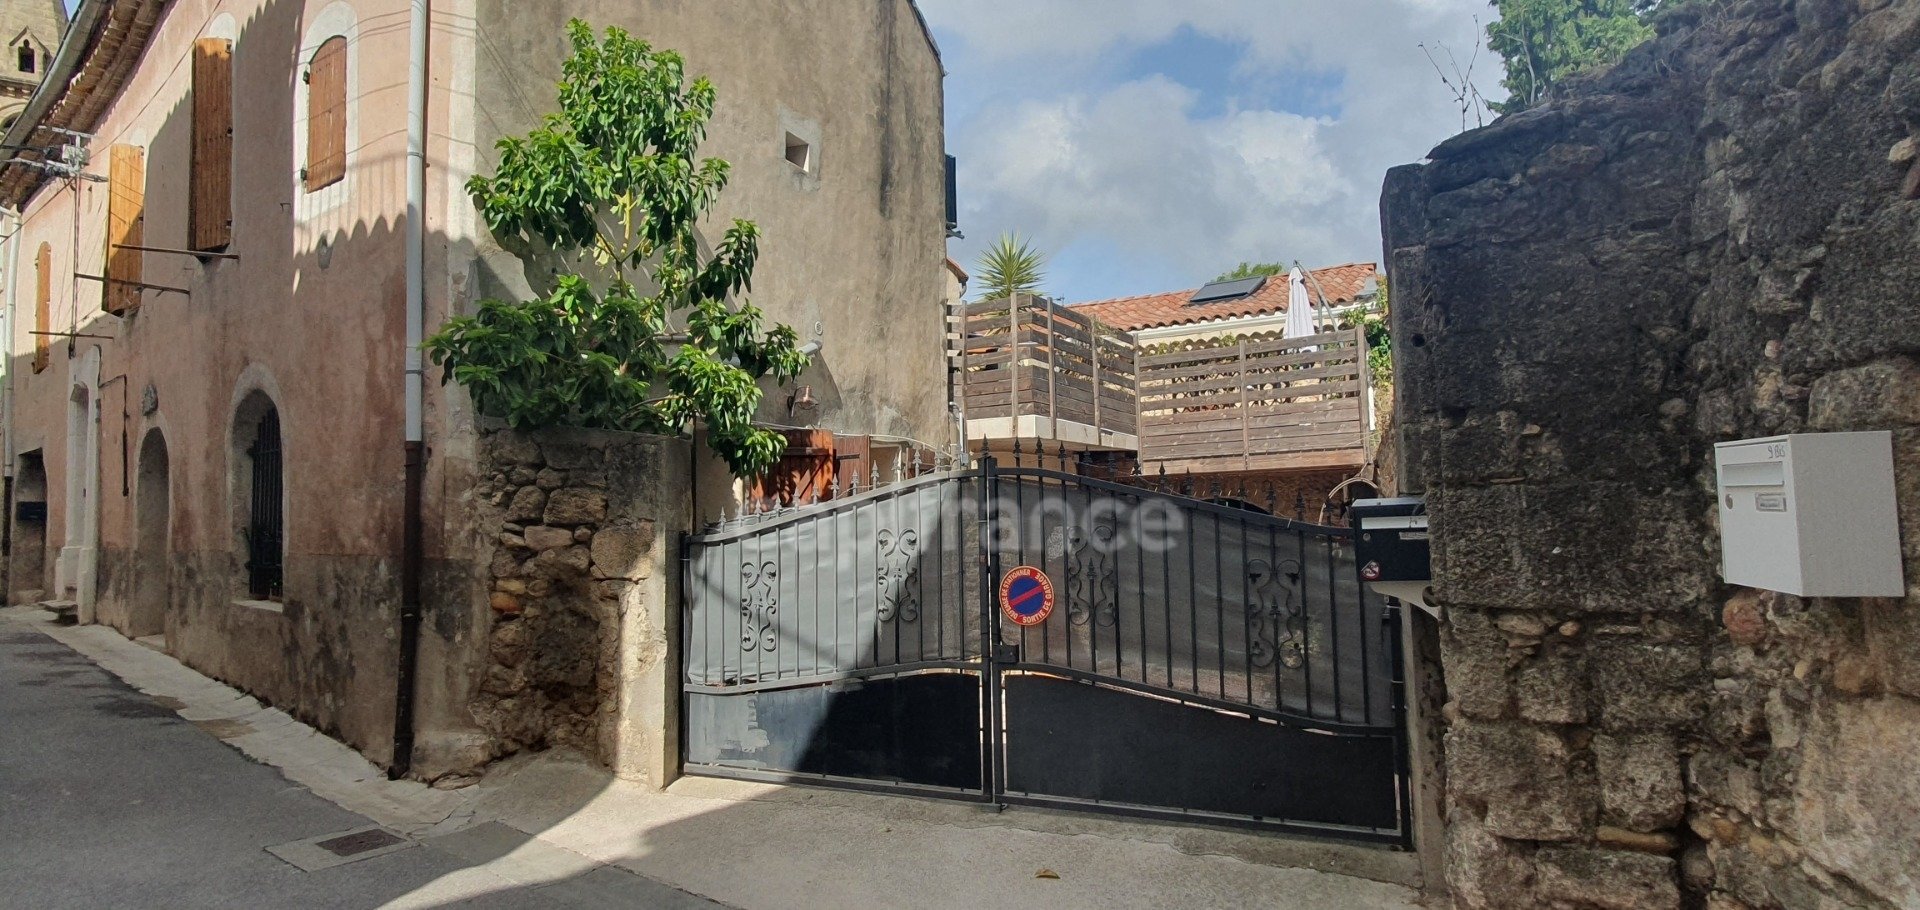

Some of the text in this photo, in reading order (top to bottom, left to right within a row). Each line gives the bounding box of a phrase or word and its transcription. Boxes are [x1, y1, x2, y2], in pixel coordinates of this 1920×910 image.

[1003, 569, 1031, 588] STATIONNER
[1022, 572, 1052, 623] SORTIE DE GARAGE
